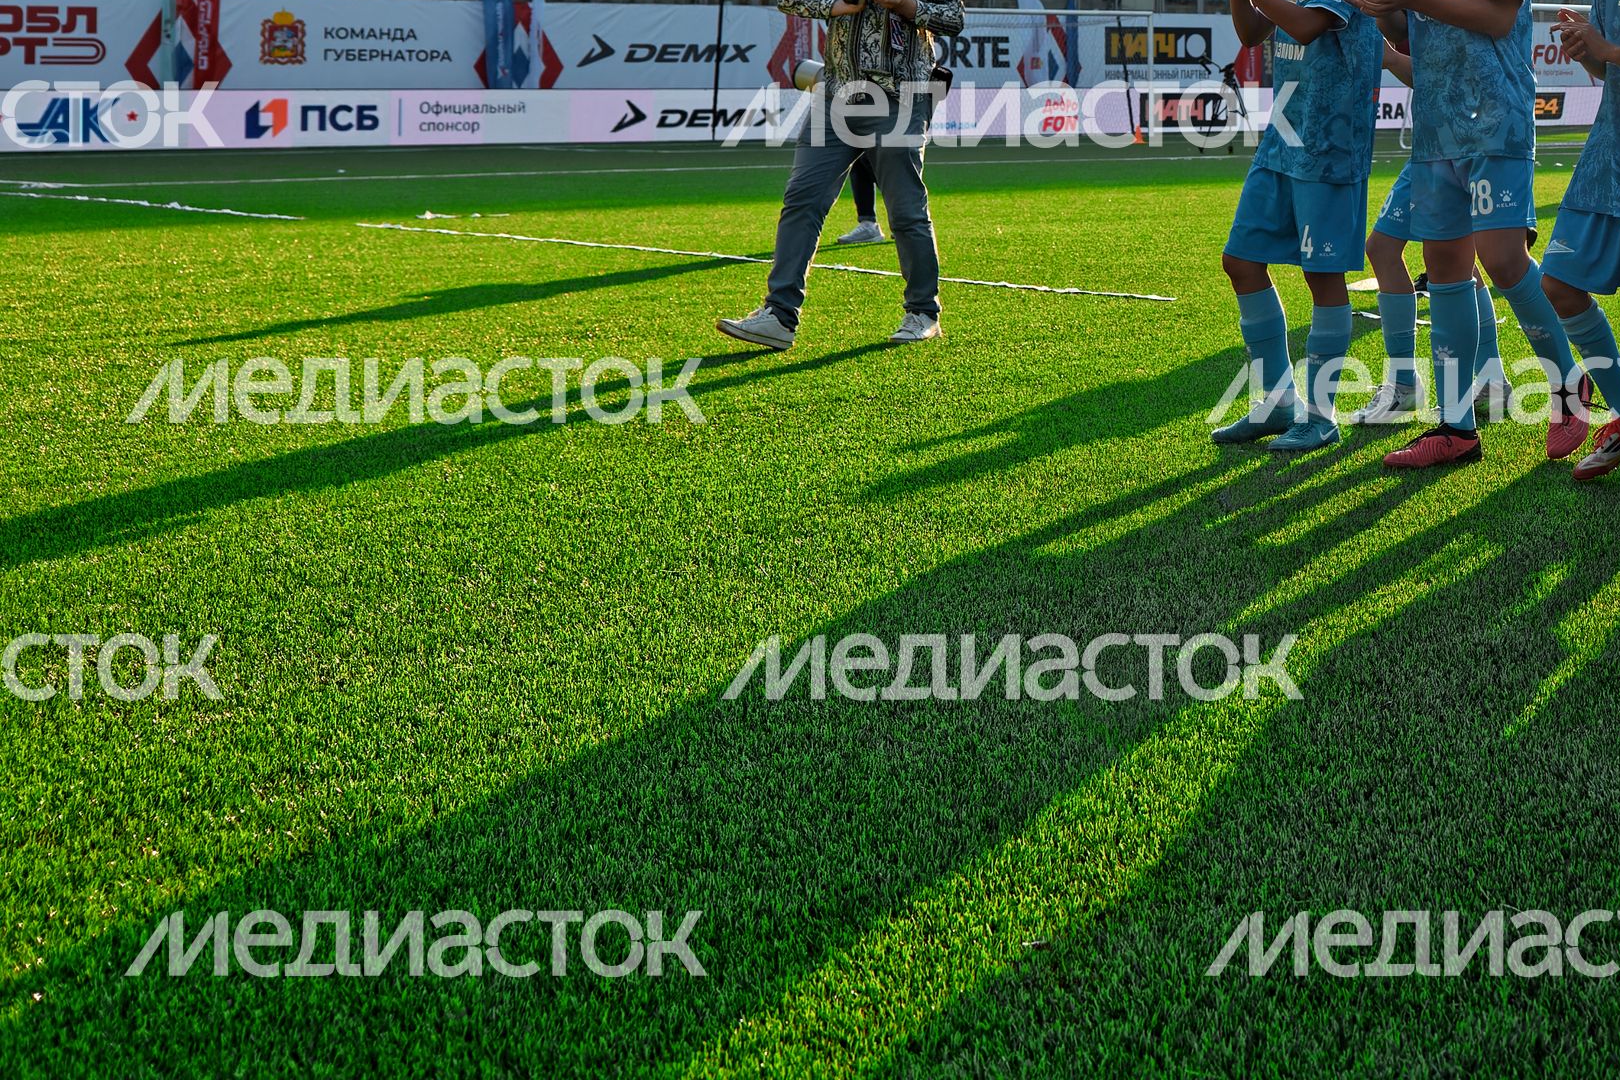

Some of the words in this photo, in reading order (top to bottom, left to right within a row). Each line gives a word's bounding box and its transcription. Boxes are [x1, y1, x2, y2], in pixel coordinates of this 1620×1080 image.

[323, 27, 418, 42] КОМАНДА
[323, 48, 453, 63] ГУБЕРНАТОРА
[419, 101, 526, 116] Официальный
[300, 104, 380, 132] ПСБ
[656, 108, 785, 128] DEMIX
[419, 120, 480, 135] спонсор
[1300, 224, 1314, 259] 4
